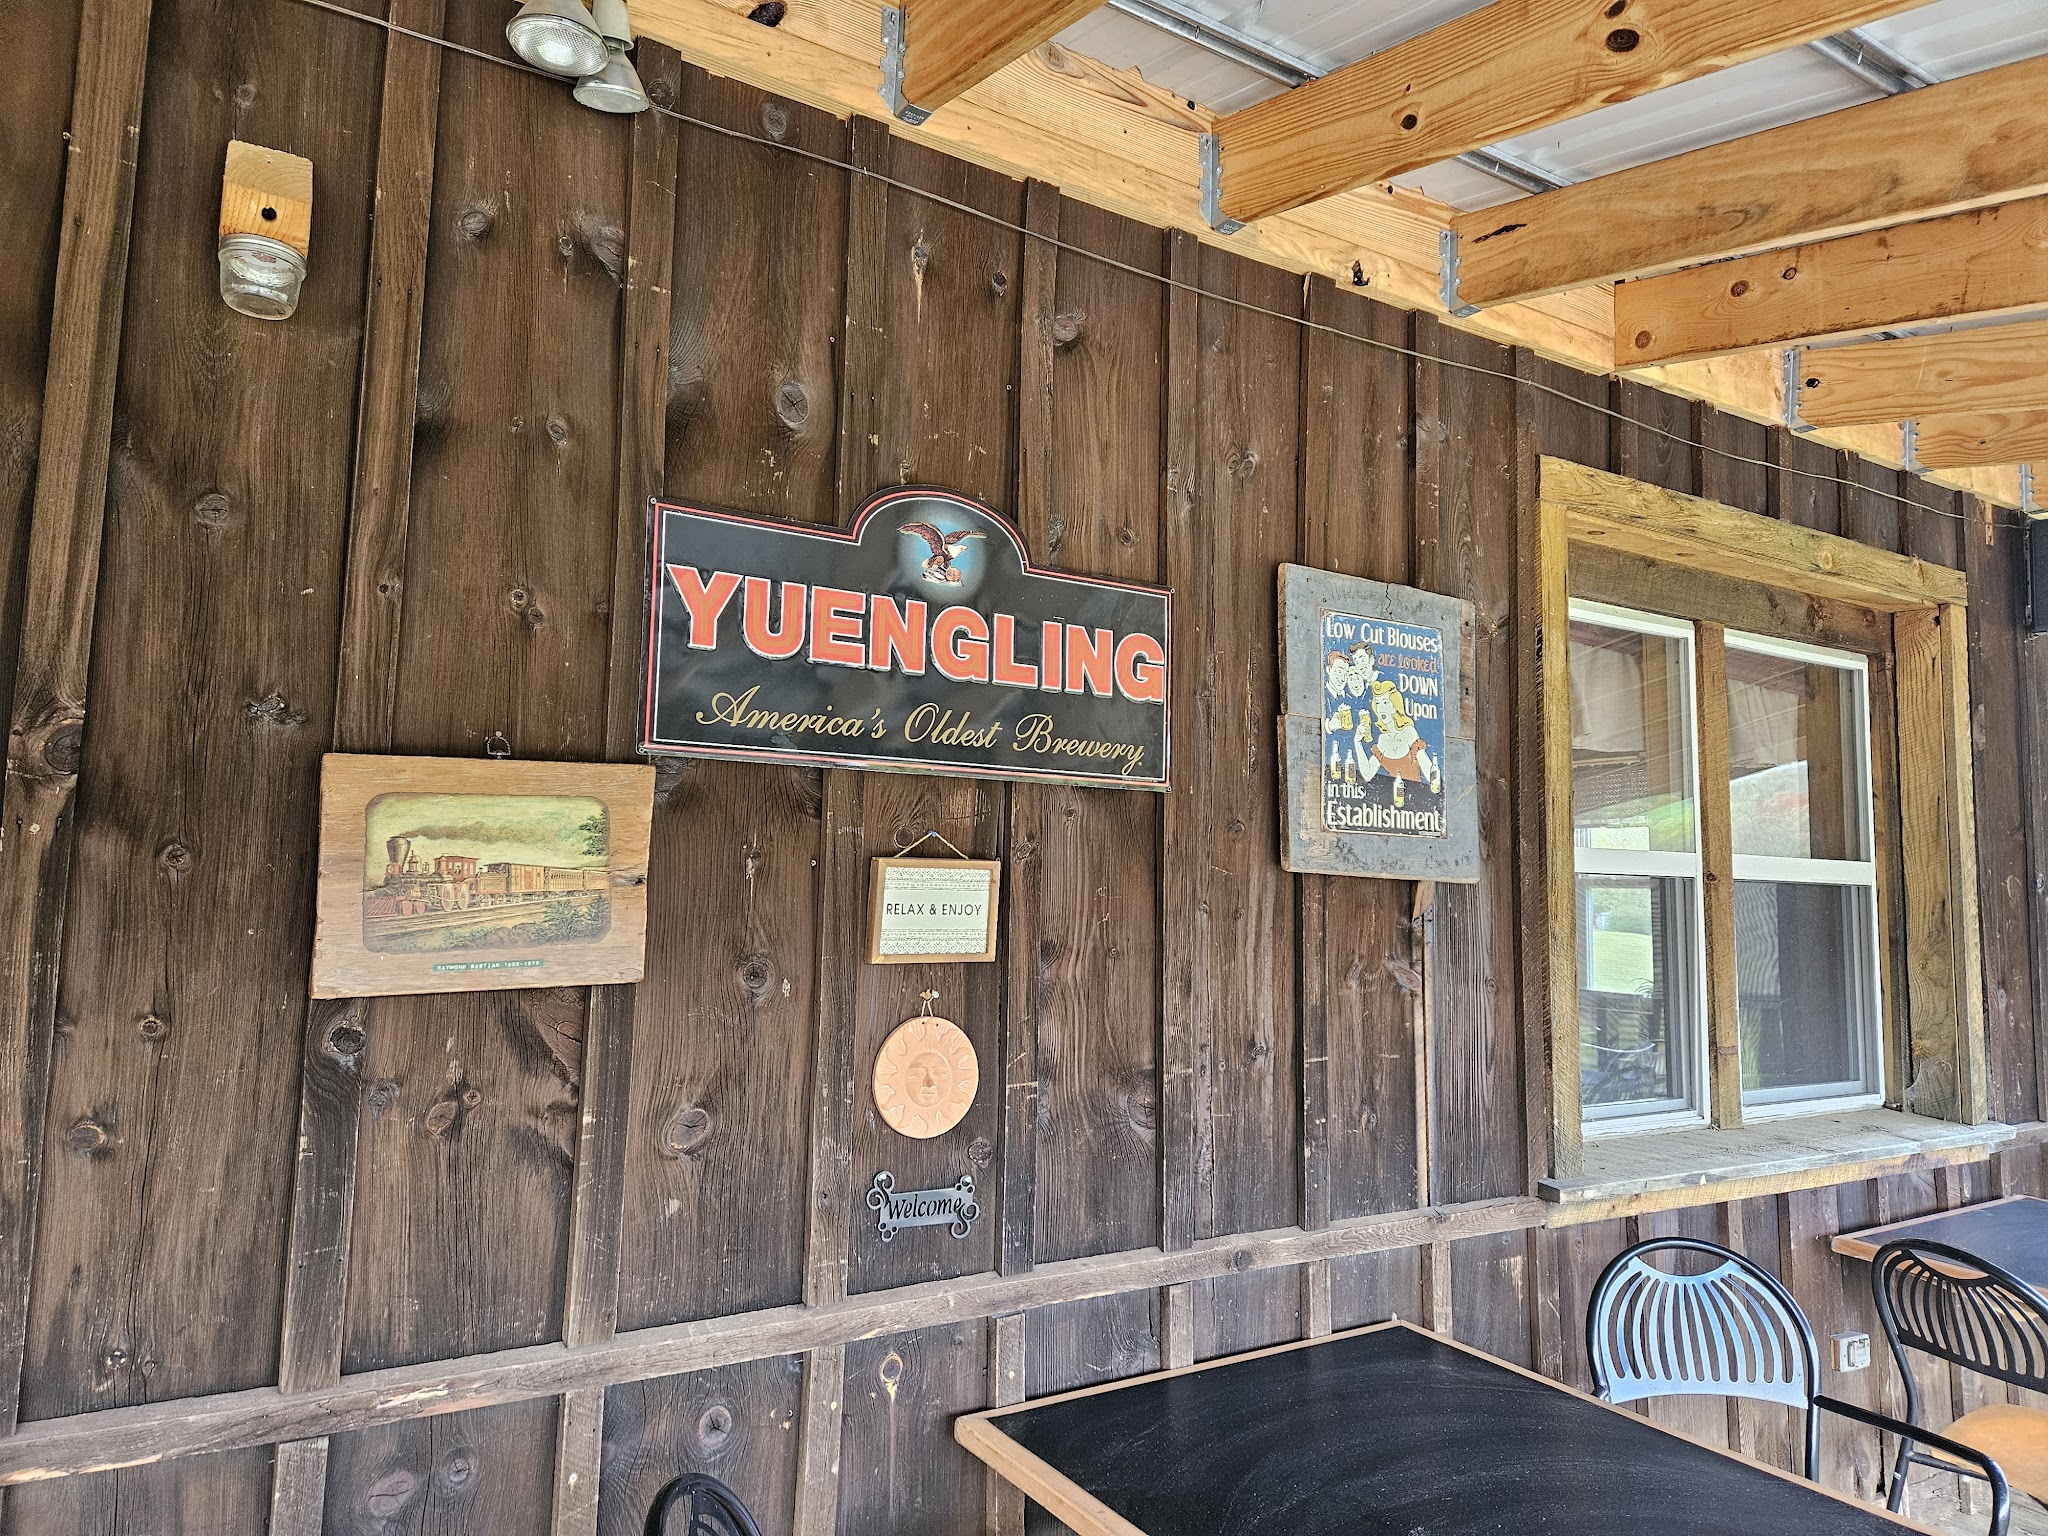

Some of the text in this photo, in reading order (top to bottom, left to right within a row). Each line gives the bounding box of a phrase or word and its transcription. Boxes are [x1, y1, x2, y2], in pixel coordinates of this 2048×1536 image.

[665, 563, 1165, 705] YUENGLING
[1325, 616, 1440, 653] Low Cut Blouses
[1378, 652, 1396, 667] are
[1398, 673, 1439, 697] DOWN
[695, 685, 888, 740] America's
[904, 702, 1003, 749] Oldest
[1405, 697, 1438, 720] Upon
[1327, 780, 1367, 800] in this
[1326, 799, 1442, 832] Establishment
[886, 903, 982, 916] RELAX & ENJOY
[886, 1193, 963, 1221] Welcome
